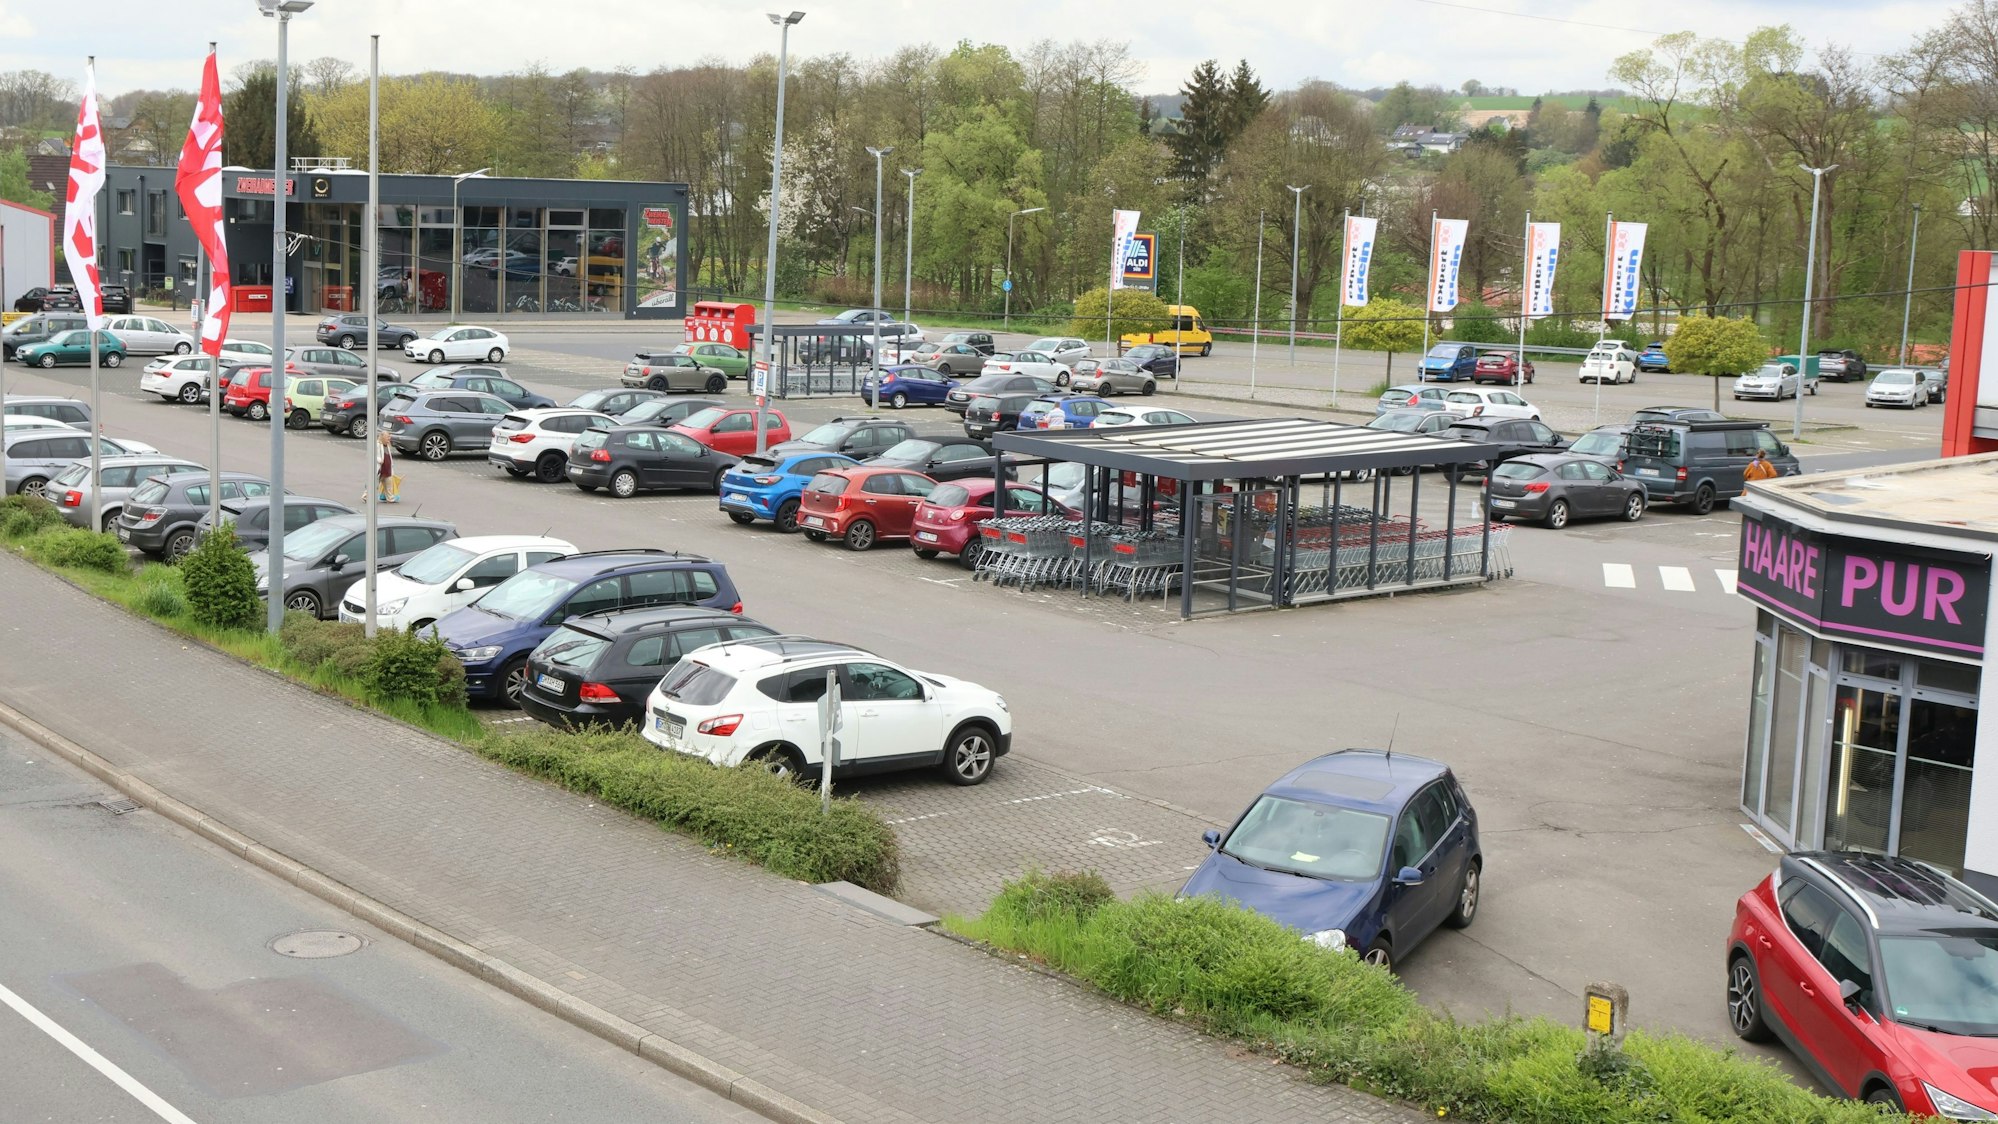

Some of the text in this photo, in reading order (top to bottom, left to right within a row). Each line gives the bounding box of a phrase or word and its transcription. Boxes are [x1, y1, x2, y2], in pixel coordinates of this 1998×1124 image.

[1126, 259, 1148, 267] ALDI
[1437, 249, 1448, 305] expert
[1744, 521, 1966, 626] HAARE PUR
